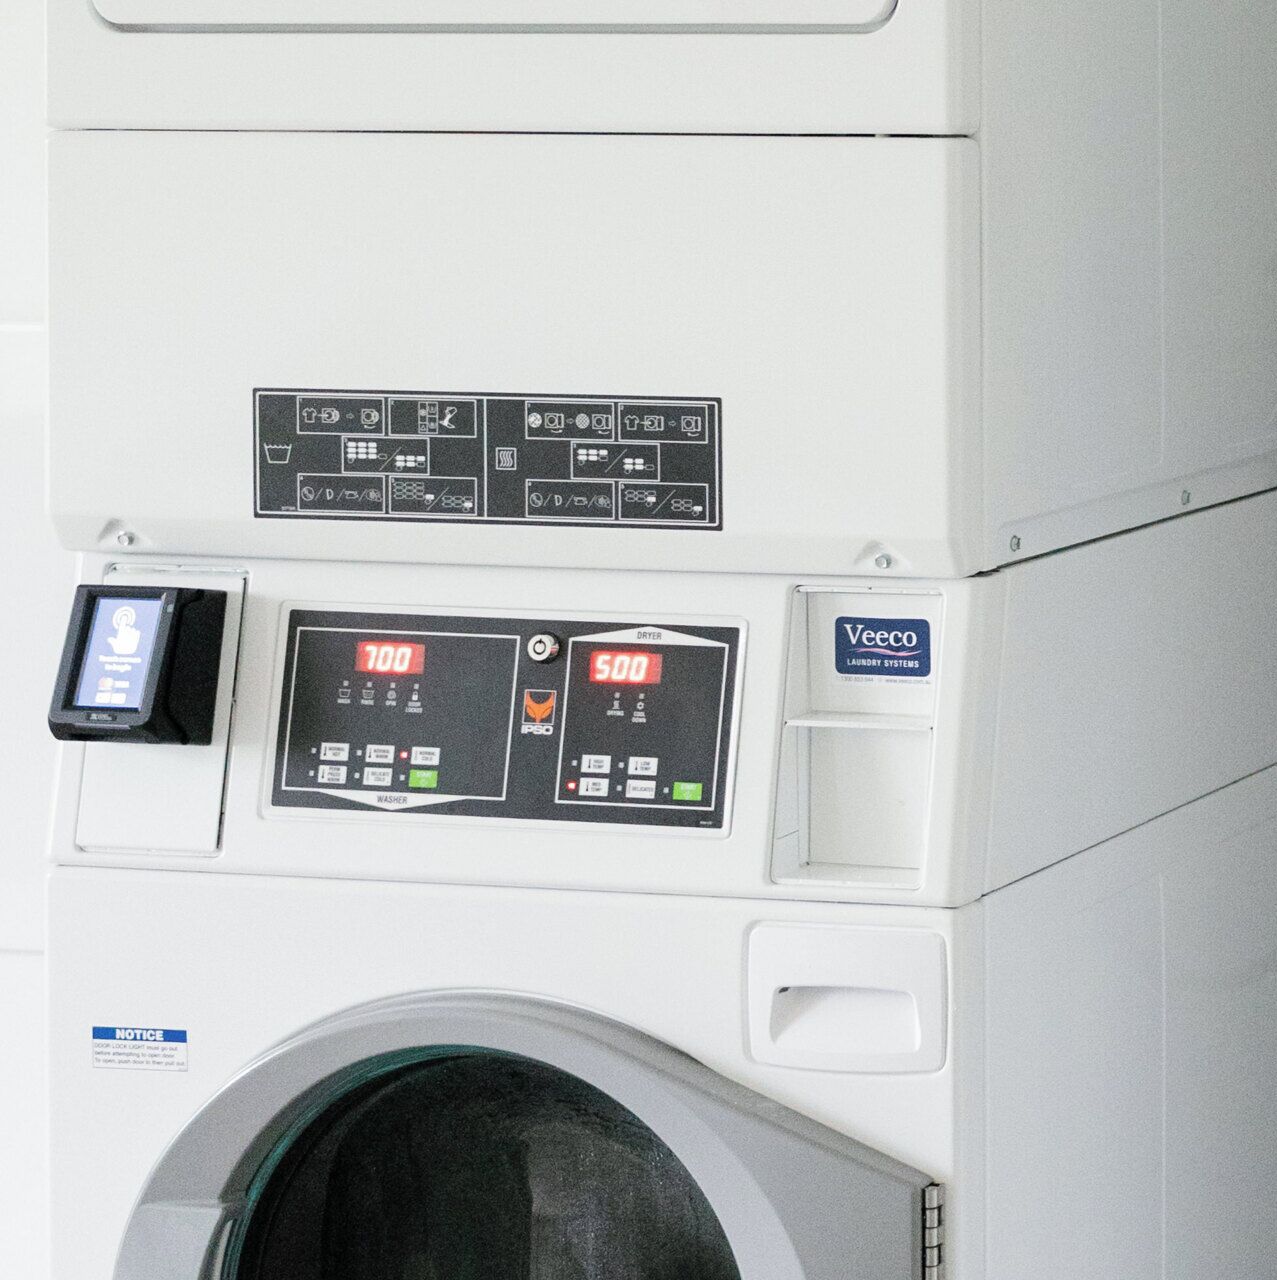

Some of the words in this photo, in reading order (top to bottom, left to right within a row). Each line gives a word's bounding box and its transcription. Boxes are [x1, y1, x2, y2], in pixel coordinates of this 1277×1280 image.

[637, 631, 662, 640] DRYER
[843, 623, 918, 647] Veeco
[365, 645, 412, 672] 700
[847, 658, 882, 667] LAUNDRY
[884, 659, 920, 669] SYSTEMS
[595, 654, 648, 681] 500
[521, 724, 553, 735] IPSO
[376, 795, 408, 804] WASHER
[115, 1028, 164, 1041] NOTICE
